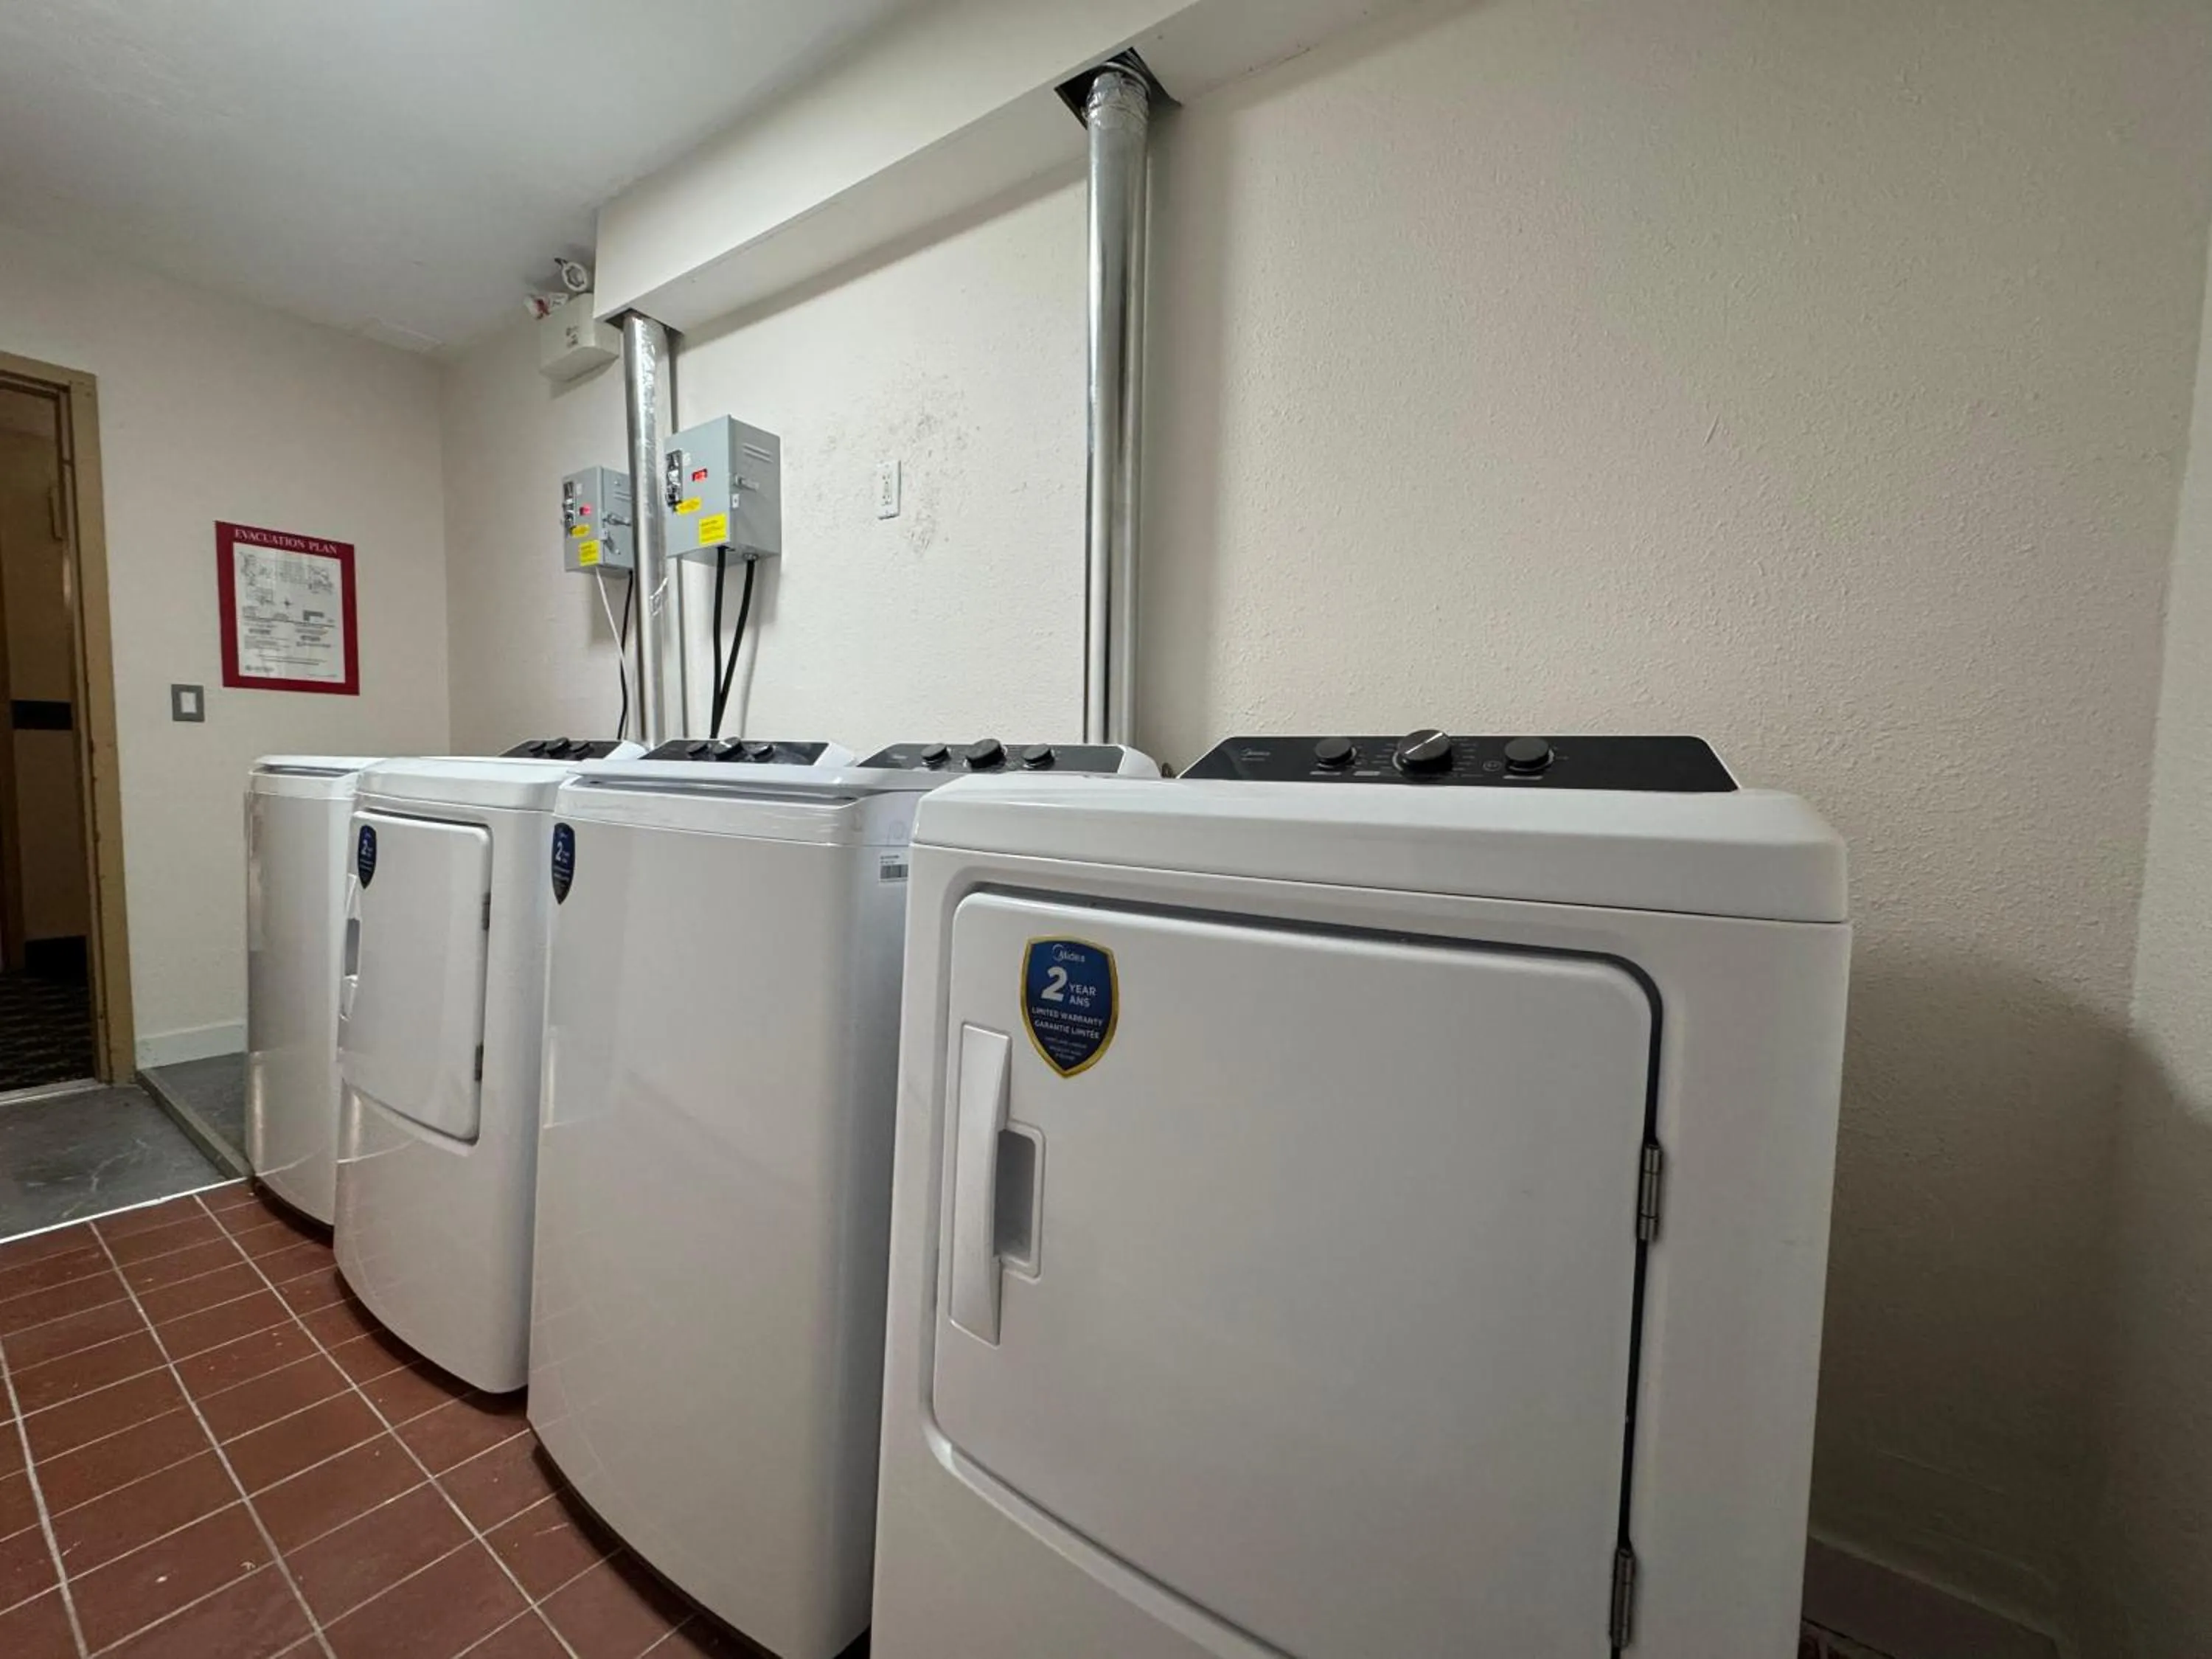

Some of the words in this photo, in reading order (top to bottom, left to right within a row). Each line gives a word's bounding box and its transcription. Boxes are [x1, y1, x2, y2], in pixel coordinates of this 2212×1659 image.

[235, 528, 305, 549] EVACUATION
[308, 540, 338, 555] PLAN
[555, 841, 563, 861] 2
[1040, 966, 1068, 1001] 2
[1069, 984, 1096, 996] YEAR
[1069, 995, 1091, 1008] ANS
[1032, 1006, 1060, 1018] LIMITED
[1060, 1012, 1103, 1027] WARRANTY
[1034, 1020, 1070, 1034] GARANTIE
